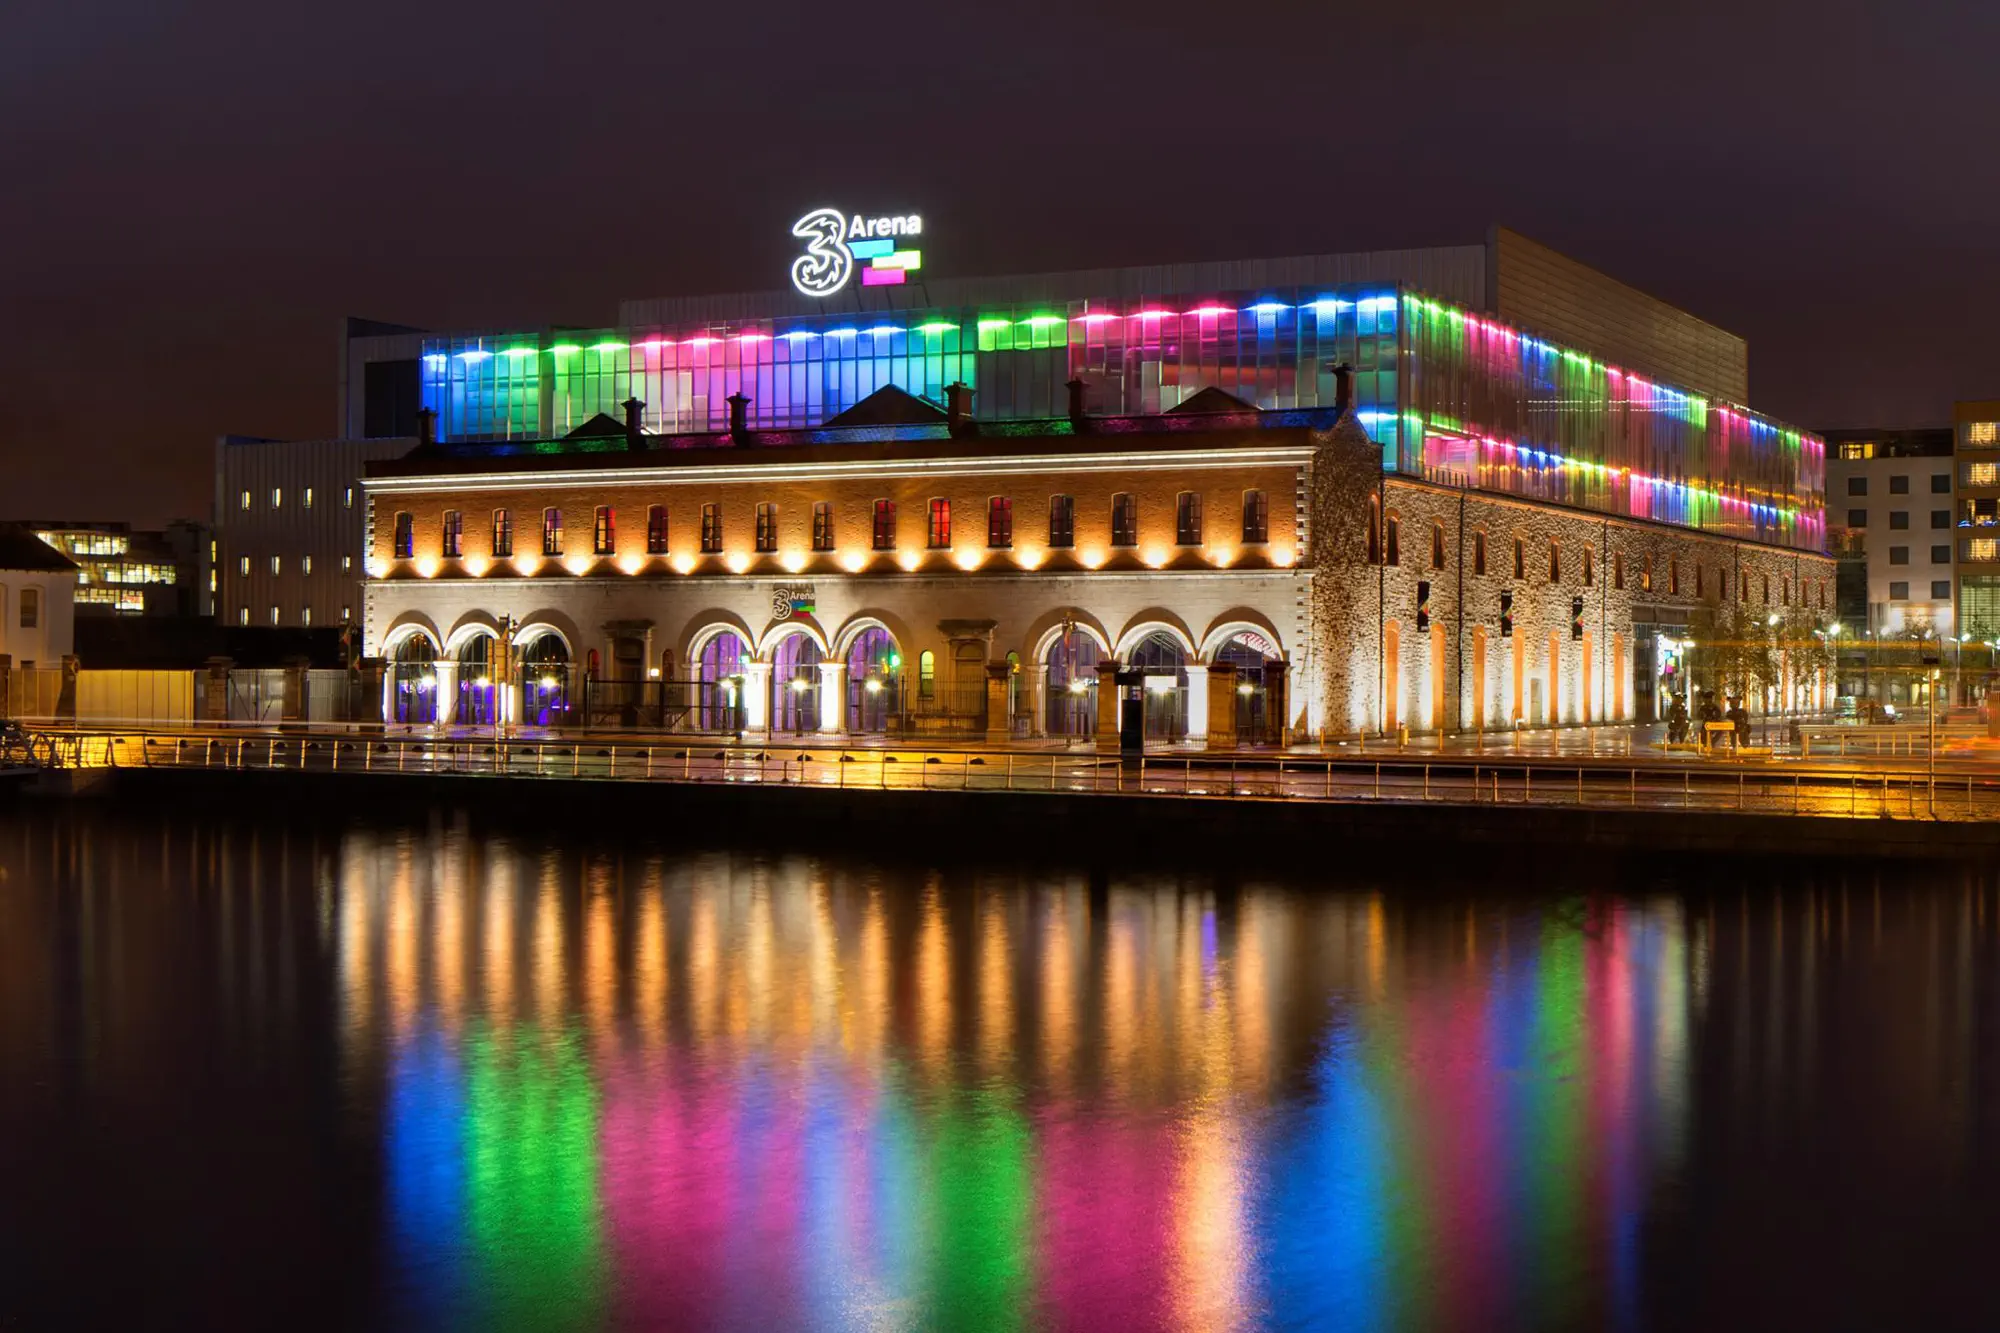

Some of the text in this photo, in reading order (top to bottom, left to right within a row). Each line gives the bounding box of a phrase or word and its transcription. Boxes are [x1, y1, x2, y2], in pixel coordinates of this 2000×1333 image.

[791, 208, 922, 297] 3 Arena
[772, 588, 816, 620] 3 Arena
